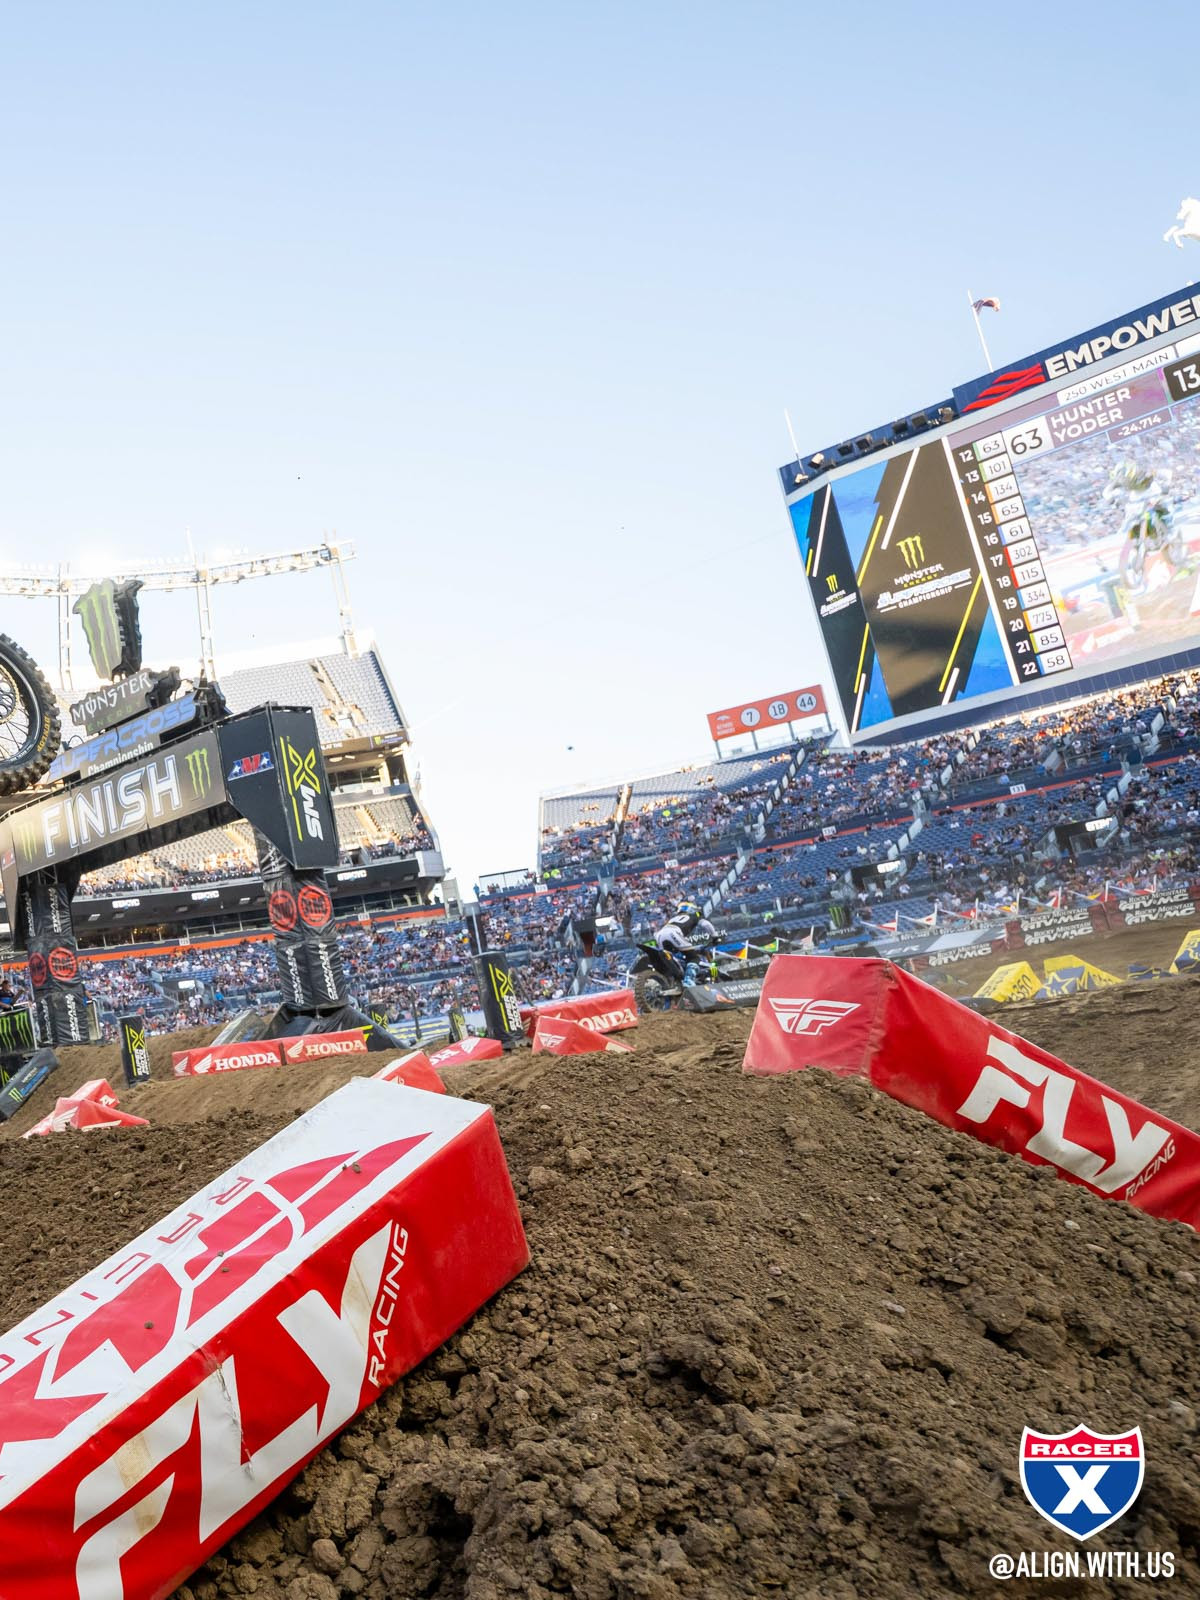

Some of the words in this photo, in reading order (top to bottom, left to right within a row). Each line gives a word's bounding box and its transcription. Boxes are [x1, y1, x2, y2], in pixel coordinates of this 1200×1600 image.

[1065, 385, 1087, 401] 250
[1090, 369, 1126, 390] WEST
[1132, 352, 1169, 374] MAIN
[1050, 387, 1131, 429] HUNTER
[1054, 408, 1123, 443] YODER
[1117, 415, 1162, 437] -24.714
[959, 449, 974, 462] 12
[982, 440, 1000, 454] 63
[1010, 428, 1043, 455] 63
[965, 470, 980, 484] 13
[988, 460, 1006, 475] 101
[971, 491, 986, 505] 14
[977, 511, 992, 525] 15
[1001, 502, 1019, 517] 65
[983, 532, 998, 546] 16
[1009, 524, 1024, 537] 61
[990, 554, 1003, 567] 17
[1014, 545, 1033, 560] 302
[894, 563, 944, 586] MONSTER
[996, 575, 1011, 589] 18
[1020, 567, 1039, 581] 115
[1002, 597, 1018, 610] 19
[1009, 618, 1024, 632] 20
[1016, 640, 1030, 654] 21
[1040, 632, 1059, 646] 85
[1022, 661, 1038, 675] 22
[1047, 655, 1065, 668] 58
[71, 671, 153, 727] MONSTER
[772, 703, 785, 717] 18
[799, 696, 814, 708] 44
[746, 711, 753, 723] 7
[37, 713, 50, 753] DUNLOP
[228, 751, 275, 781] AMA
[40, 754, 182, 858] FINISH
[1151, 888, 1187, 900] MOUNTAIN
[1054, 907, 1088, 919] MOUNTAIN
[1156, 902, 1194, 914] MOUNTAIN
[1056, 921, 1091, 933] MOUNTAIN
[305, 1039, 366, 1056] HONDA
[214, 1051, 280, 1071] HONDA
[956, 1034, 1172, 1194] FLY
[1124, 1139, 1176, 1201] RACING
[367, 1222, 409, 1388] RACING
[75, 1220, 393, 1600] FLY
